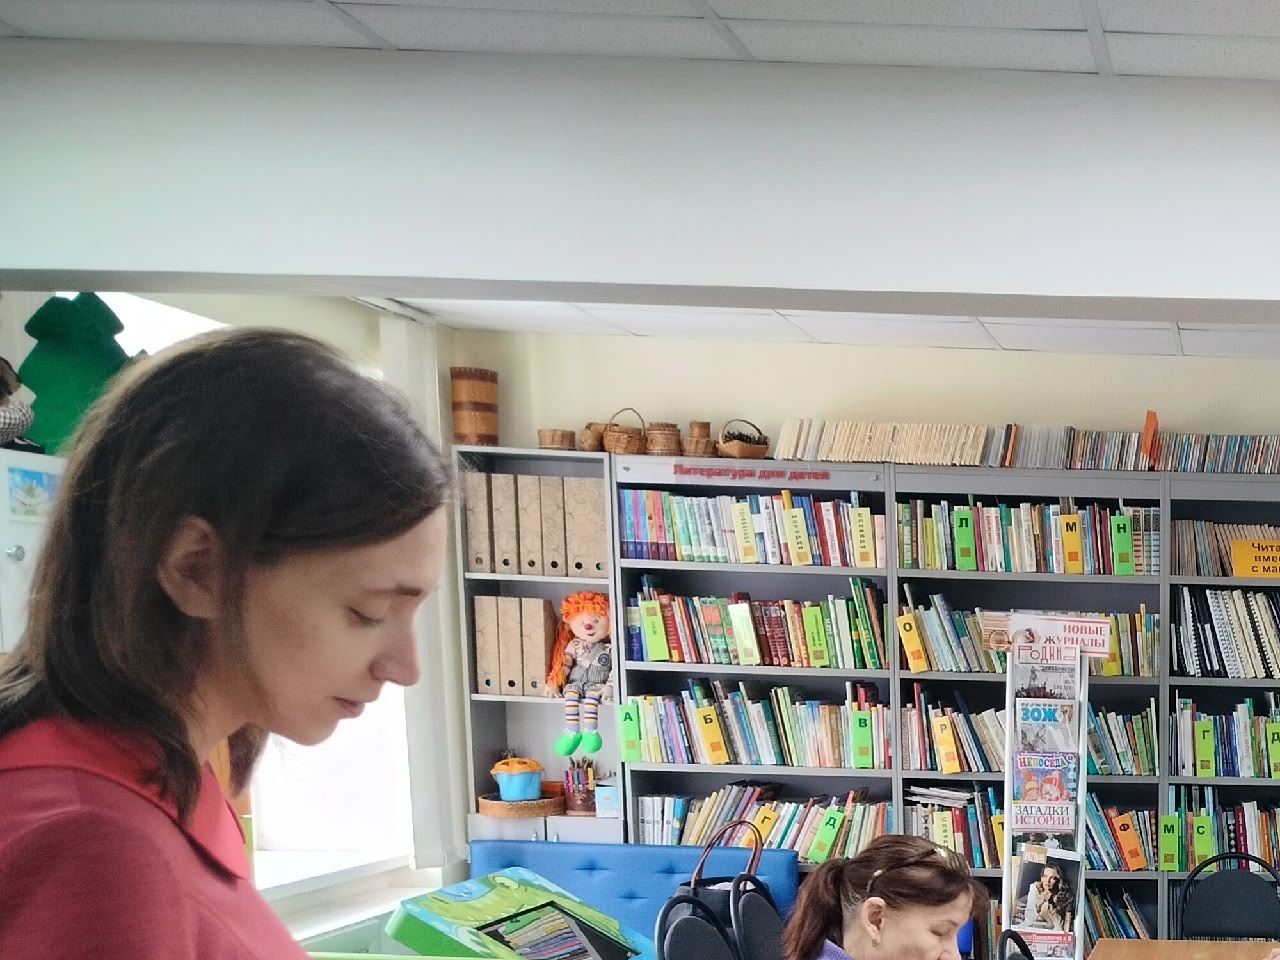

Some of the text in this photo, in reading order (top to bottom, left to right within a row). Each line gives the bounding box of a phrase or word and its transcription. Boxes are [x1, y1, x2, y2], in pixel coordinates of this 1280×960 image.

[673, 464, 831, 481] Литература для детей
[958, 517, 969, 528] Л
[1066, 522, 1077, 533] М
[1116, 523, 1126, 533] Н
[1251, 565, 1259, 573] с
[903, 622, 913, 632] О
[1063, 624, 1106, 636] НОВЫЕ
[1043, 636, 1106, 648] ЖУРНАЛЫ
[623, 712, 633, 722] А
[703, 714, 714, 725] Б
[1021, 708, 1059, 722] ЗОЖ
[858, 718, 868, 728] В
[940, 724, 947, 734] Р
[1203, 730, 1210, 740] Г
[1018, 757, 1067, 769] НЕПОСЕДА
[1015, 805, 1069, 815] ЗАГАДКИ
[760, 815, 771, 825] Г
[825, 817, 838, 829] Д
[1015, 815, 1070, 825] ИСТОРИИ
[1119, 823, 1130, 832] Ф
[1163, 824, 1174, 834] М
[1197, 825, 1206, 835] С
